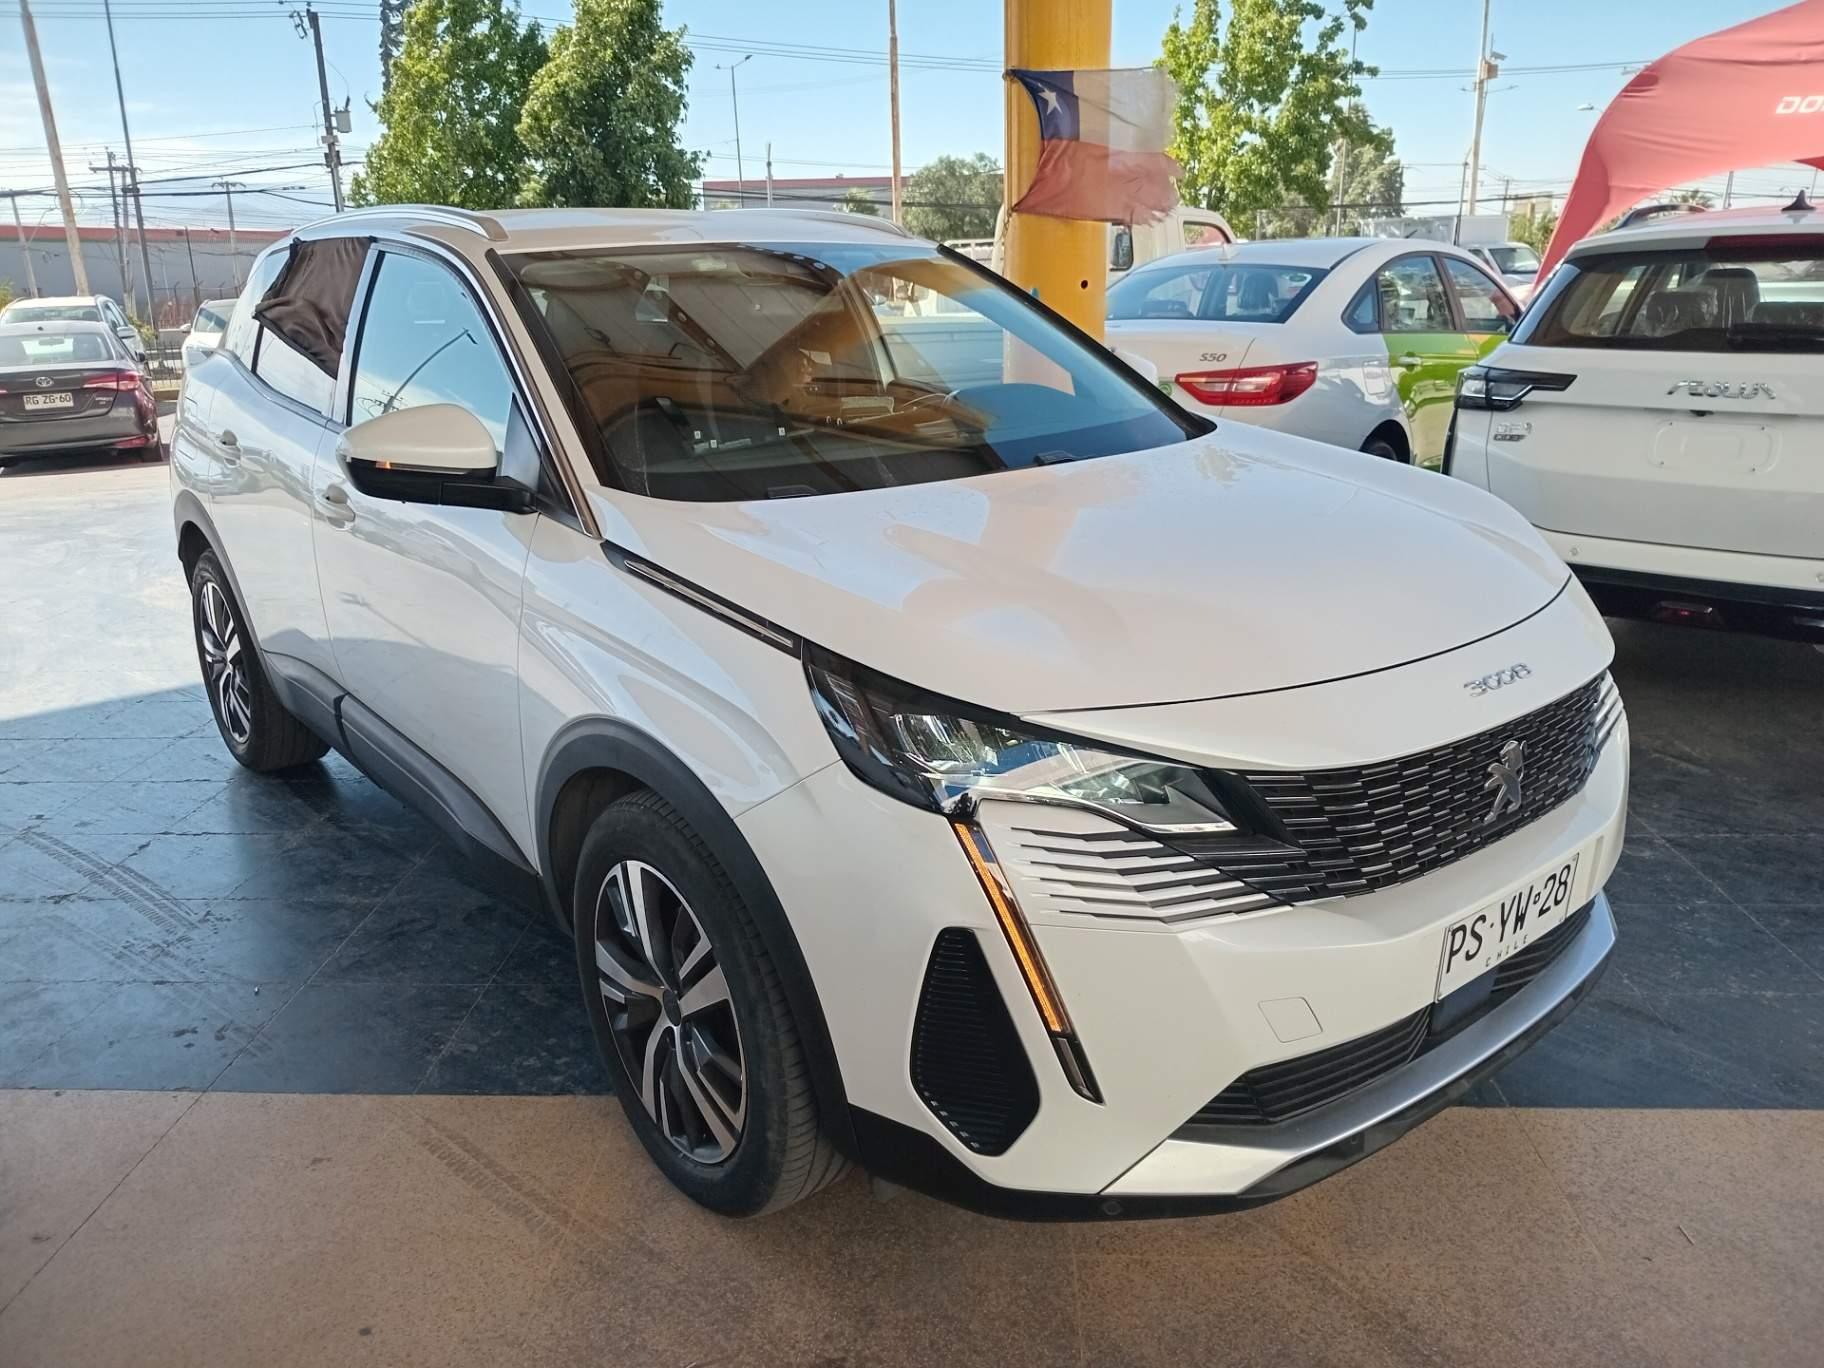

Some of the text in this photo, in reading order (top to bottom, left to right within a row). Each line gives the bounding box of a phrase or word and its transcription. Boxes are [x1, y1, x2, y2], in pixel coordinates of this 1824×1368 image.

[1776, 95, 1824, 114] DO
[1199, 352, 1228, 362] S50
[1463, 662, 1532, 697] 3008
[1485, 934, 1529, 968] CHILE
